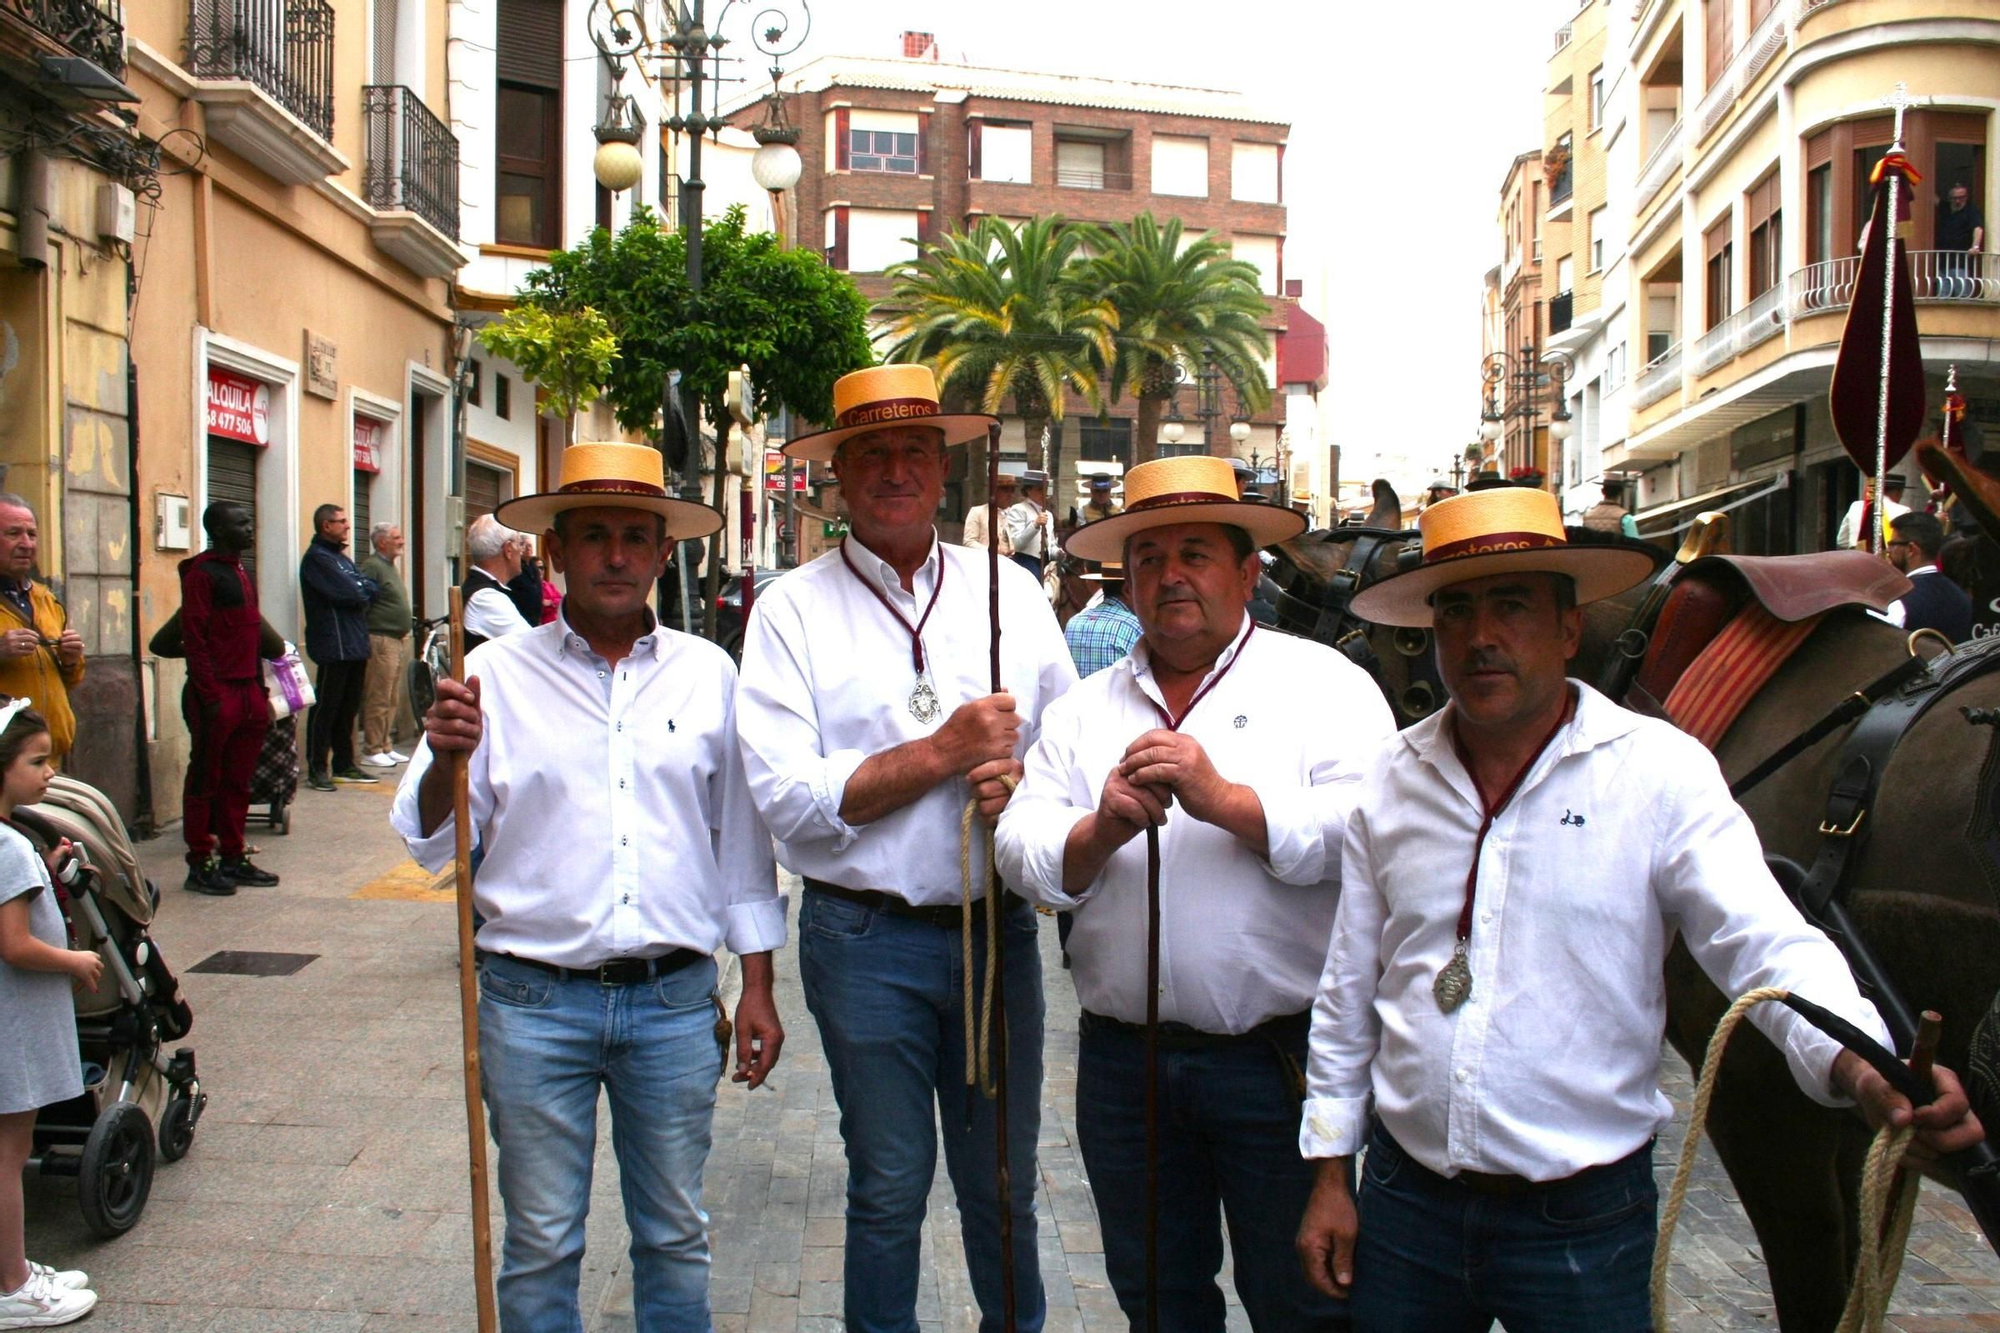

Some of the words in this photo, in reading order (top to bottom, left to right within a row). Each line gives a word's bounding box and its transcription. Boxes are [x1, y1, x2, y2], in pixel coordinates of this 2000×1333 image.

[207, 380, 251, 414] ALQUILA
[218, 411, 235, 431] 477
[236, 416, 252, 435] 506
[848, 402, 932, 426] Carreteros
[770, 474, 787, 482] REIN
[1972, 623, 2000, 640] Caf
